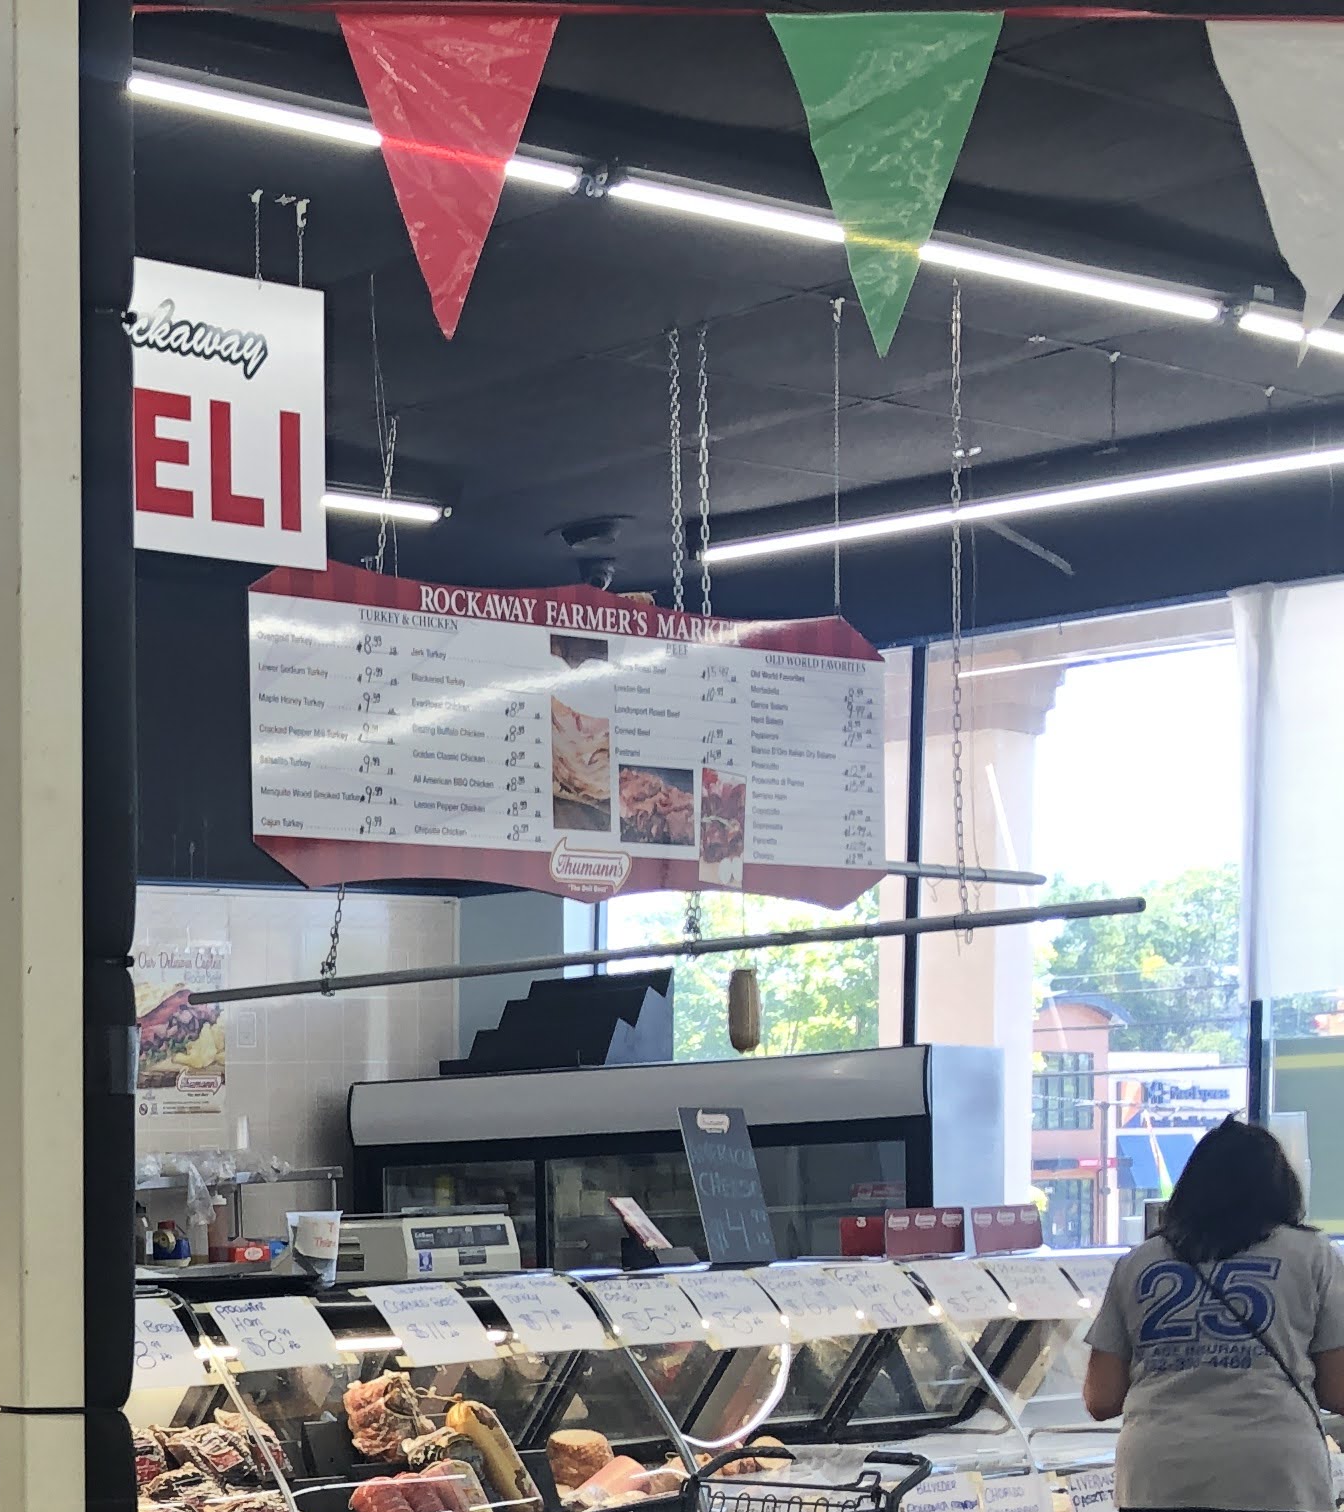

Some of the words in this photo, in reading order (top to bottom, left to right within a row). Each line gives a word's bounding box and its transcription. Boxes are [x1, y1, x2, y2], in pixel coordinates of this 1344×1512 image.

[132, 298, 267, 377] ckaway
[134, 388, 301, 532] ELI
[359, 608, 400, 625] TURKEY
[402, 615, 409, 625] &
[412, 615, 458, 630] CHICKEN
[420, 585, 537, 624] ROCKAWAY
[544, 599, 648, 639] FARMER'S
[657, 613, 741, 647] MARKET
[666, 643, 689, 656] BEEF
[765, 654, 784, 667] OLD
[786, 656, 819, 669] WORLD
[821, 659, 866, 673] FAVORITES
[280, 695, 302, 707] Honey
[304, 697, 324, 709] Turkey
[413, 749, 434, 760] Golden
[437, 751, 458, 762] Classic
[460, 753, 485, 763] Chicken
[422, 776, 452, 787] American
[469, 779, 494, 788] Chicken
[261, 817, 280, 829] Cajun
[283, 818, 304, 831] Turkey
[556, 853, 627, 881] Thumann's
[1137, 1258, 1281, 1348] 25
[232, 1317, 263, 1331] Ham
